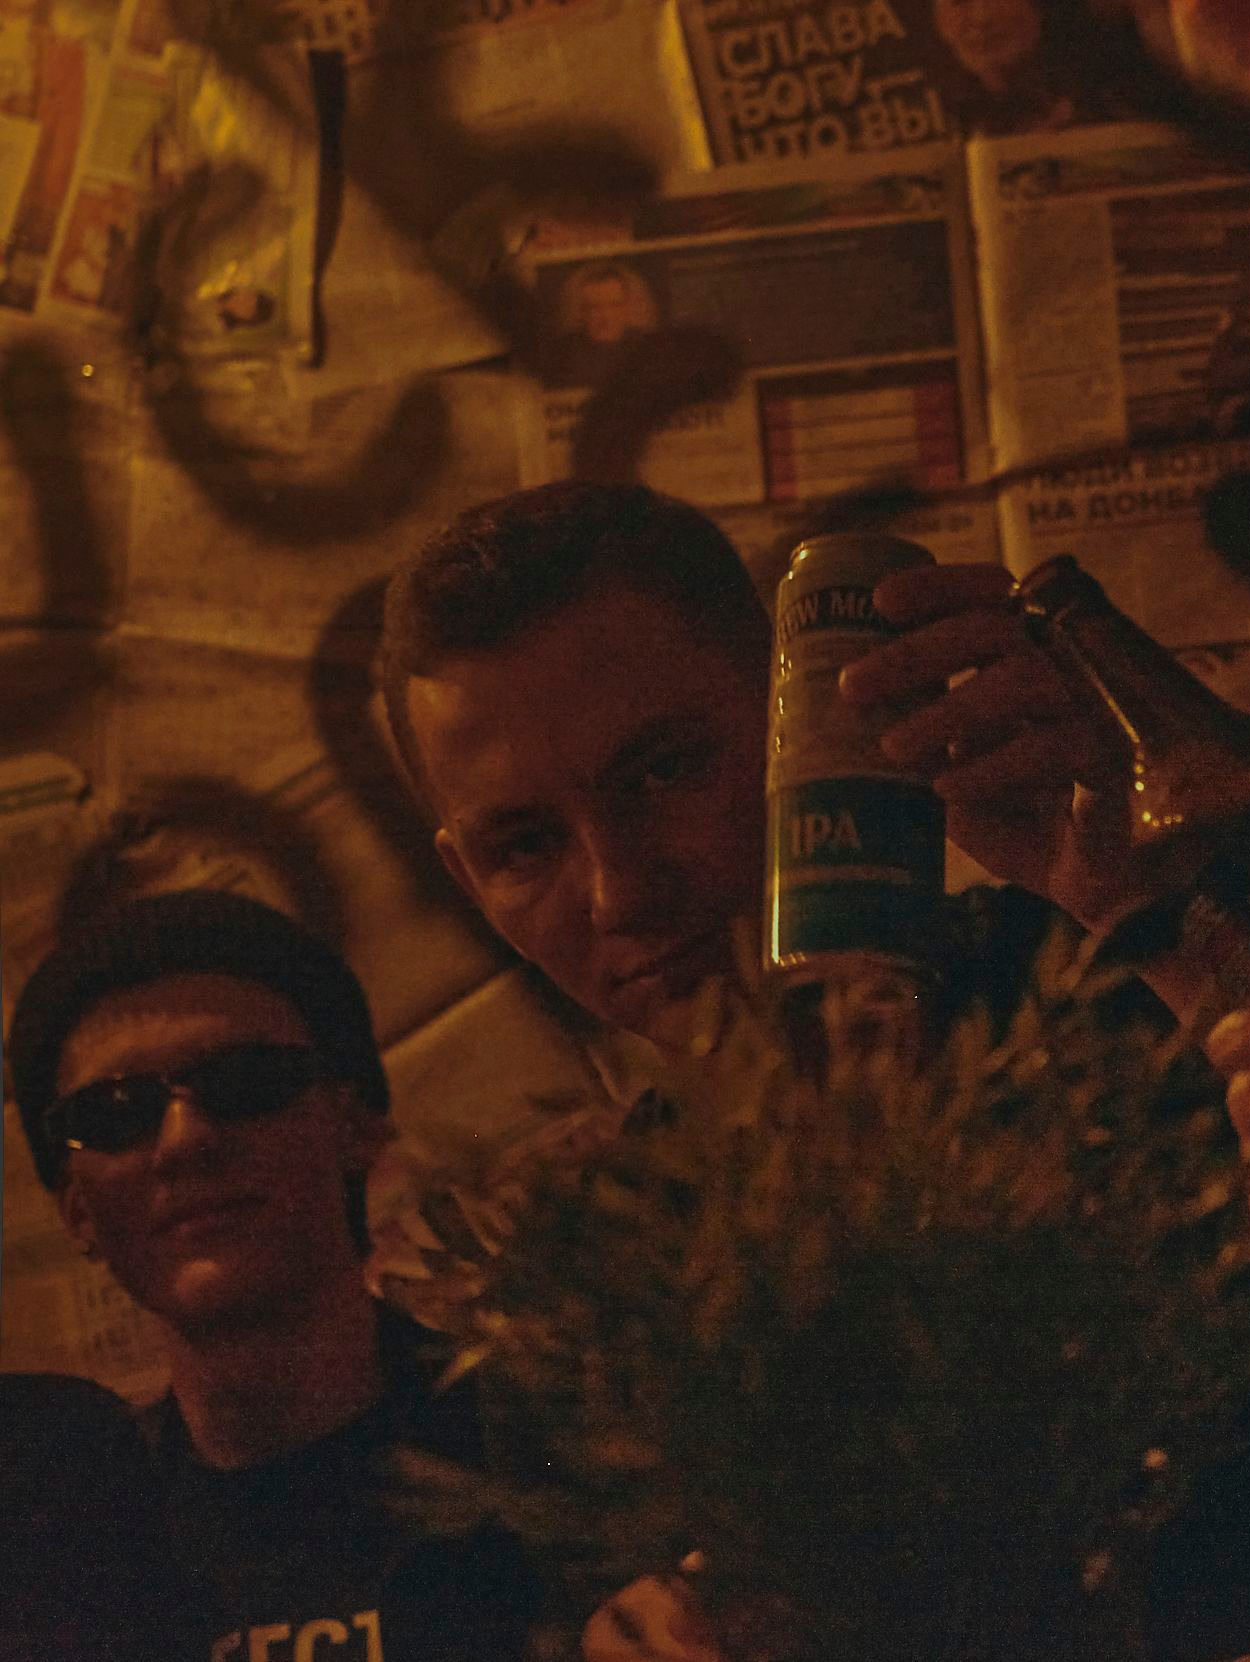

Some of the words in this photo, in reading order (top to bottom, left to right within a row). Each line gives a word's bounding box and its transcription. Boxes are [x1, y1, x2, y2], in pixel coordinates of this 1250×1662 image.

[721, 0, 907, 77] СЛАВА
[857, 88, 947, 148] ВЫ
[1027, 497, 1076, 524] НА
[789, 808, 864, 858] IPA
